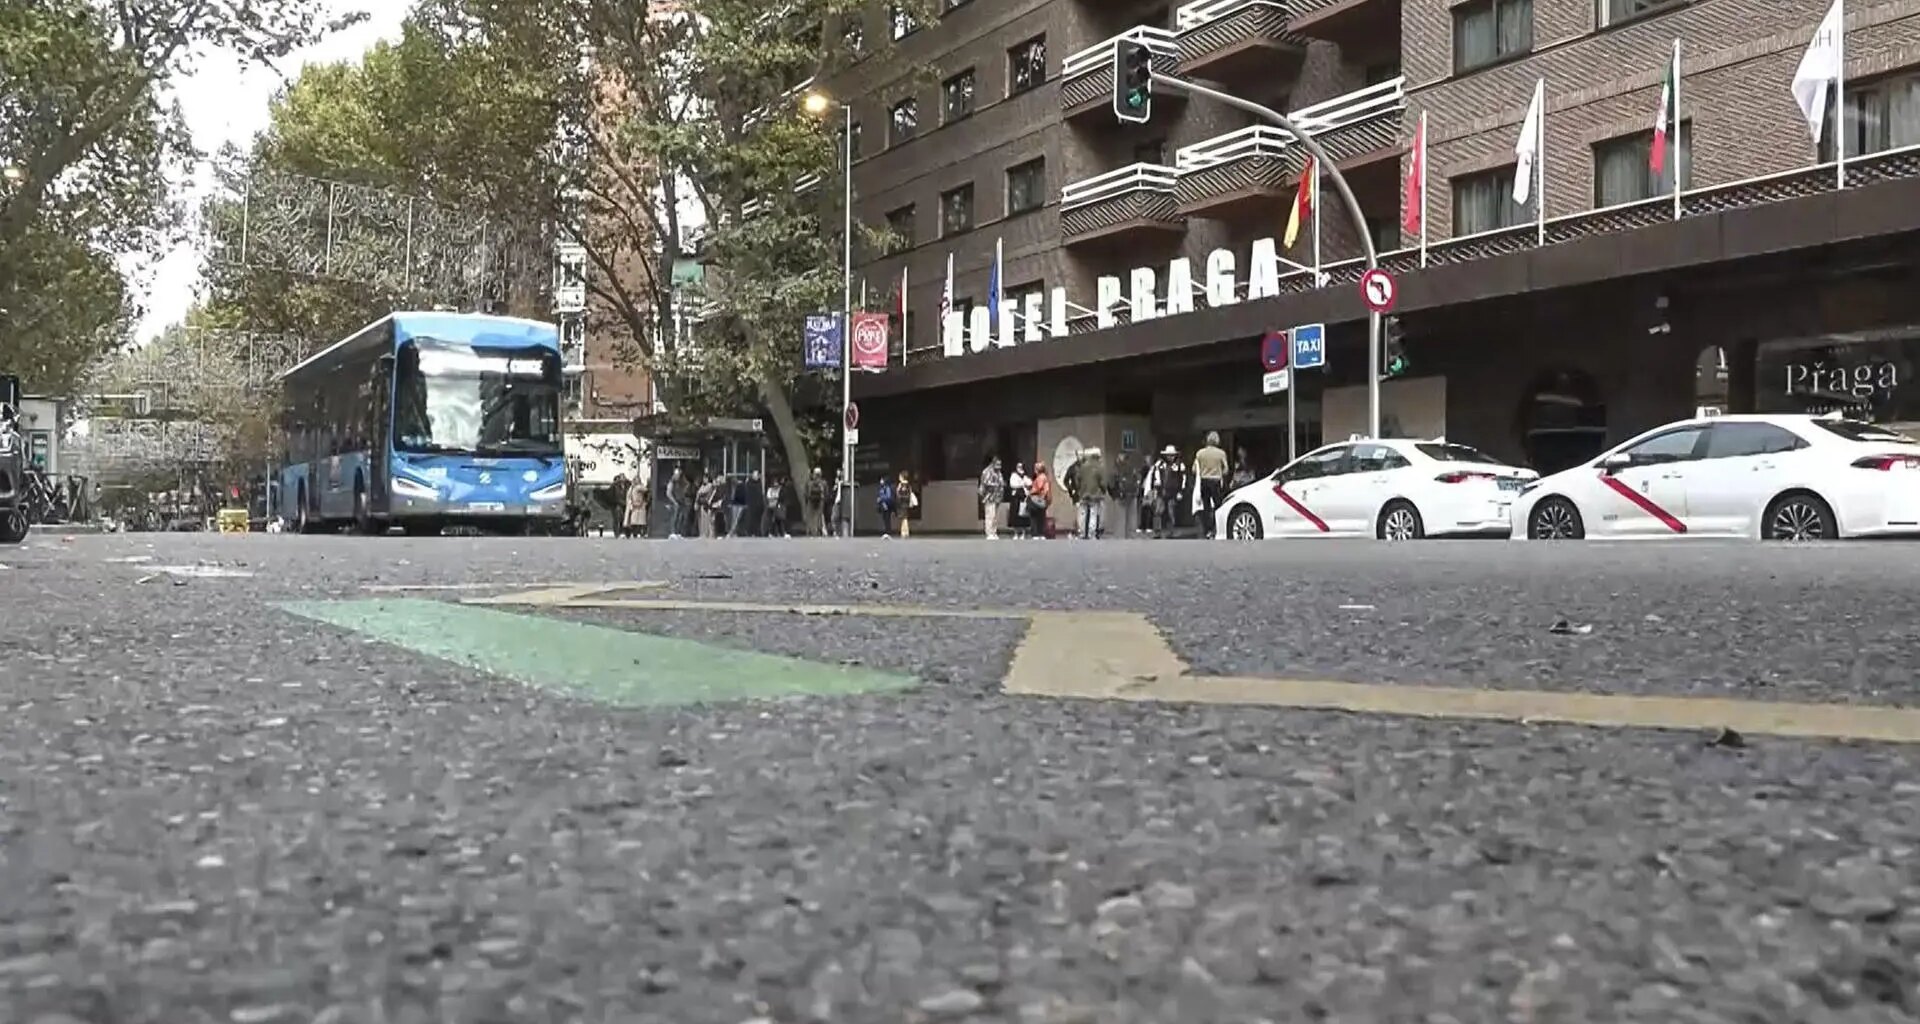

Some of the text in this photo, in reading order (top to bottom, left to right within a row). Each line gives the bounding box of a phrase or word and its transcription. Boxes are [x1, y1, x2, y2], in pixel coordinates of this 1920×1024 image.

[943, 237, 1280, 358] HOTEL PRAGA
[1296, 338, 1321, 354] TAXI
